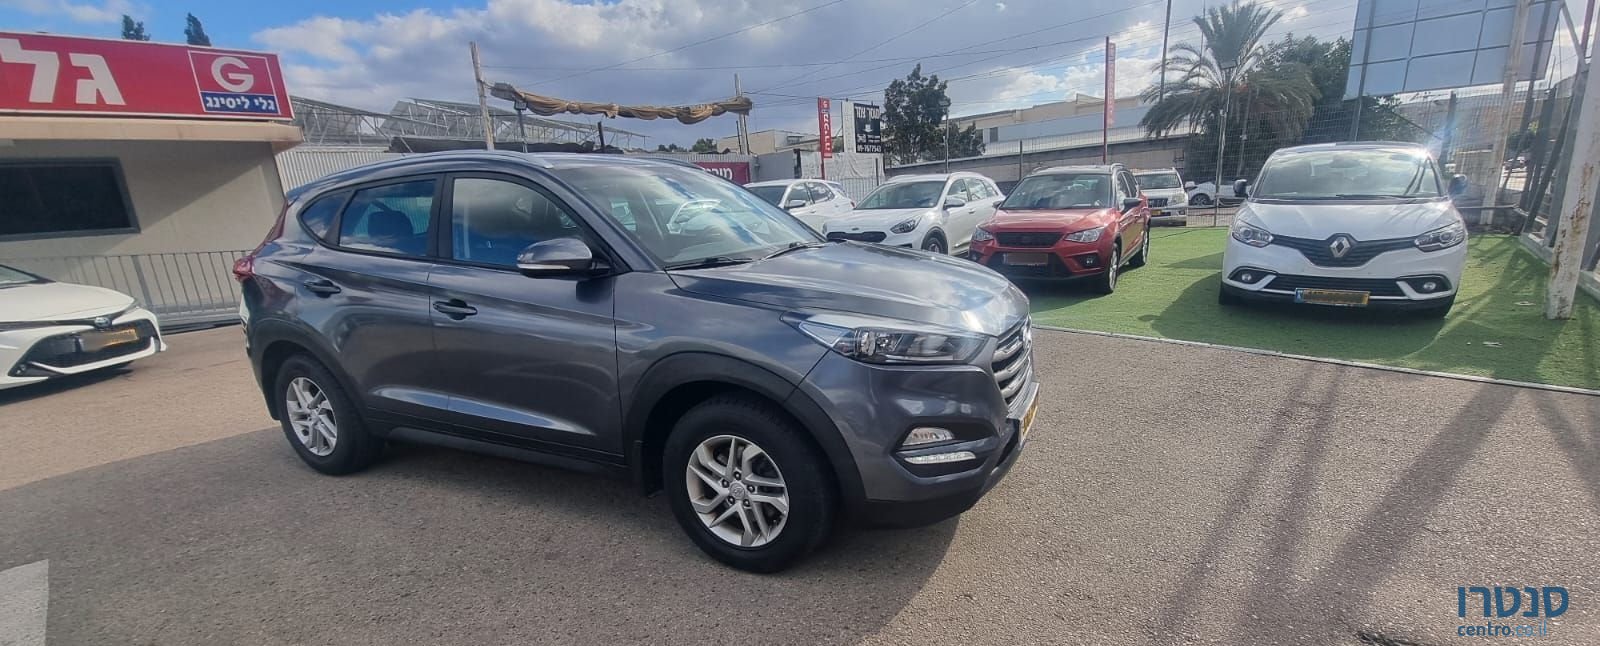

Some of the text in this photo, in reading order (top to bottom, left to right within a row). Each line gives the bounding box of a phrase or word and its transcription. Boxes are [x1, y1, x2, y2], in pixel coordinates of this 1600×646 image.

[211, 56, 254, 93] G
[205, 95, 276, 110] גלי ליסינג
